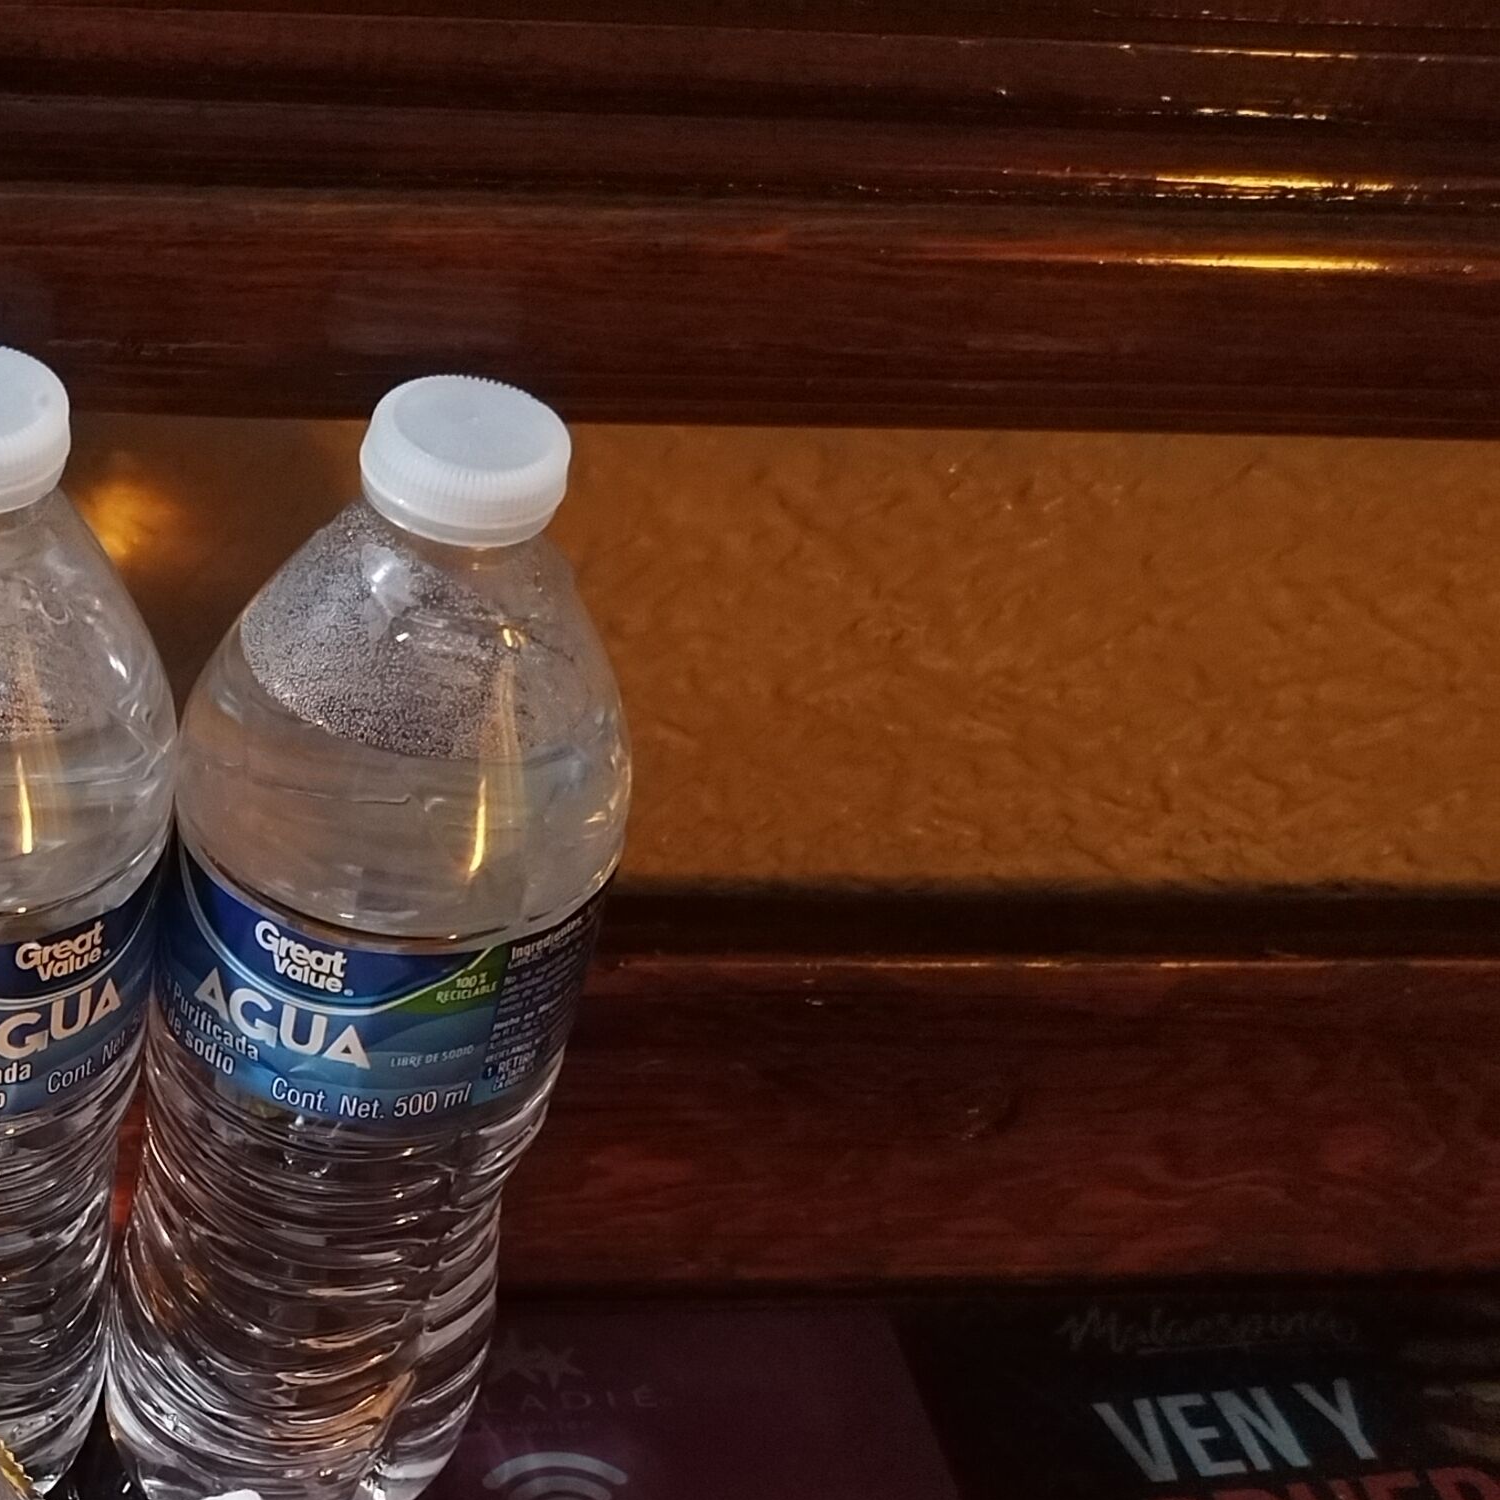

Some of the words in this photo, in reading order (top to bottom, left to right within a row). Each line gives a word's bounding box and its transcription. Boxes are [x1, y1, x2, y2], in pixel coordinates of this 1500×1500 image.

[15, 920, 104, 971] Great
[37, 947, 102, 982] Value
[255, 919, 348, 979] Great
[274, 953, 344, 993] Value
[436, 981, 499, 1004] RECICLABLE
[173, 980, 260, 1063] Purificada
[194, 966, 371, 1070] AGUA
[184, 1029, 236, 1076] sodio
[390, 1054, 423, 1068] LIBRE
[442, 1044, 476, 1062] SODIO
[47, 1057, 97, 1094] Cont.
[271, 1077, 331, 1113] Cont.
[339, 1096, 385, 1121] Net.
[393, 1089, 438, 1118] 500
[443, 1081, 473, 1108] ml
[1091, 1385, 1314, 1483] VEN
[1292, 1376, 1379, 1462] Y
